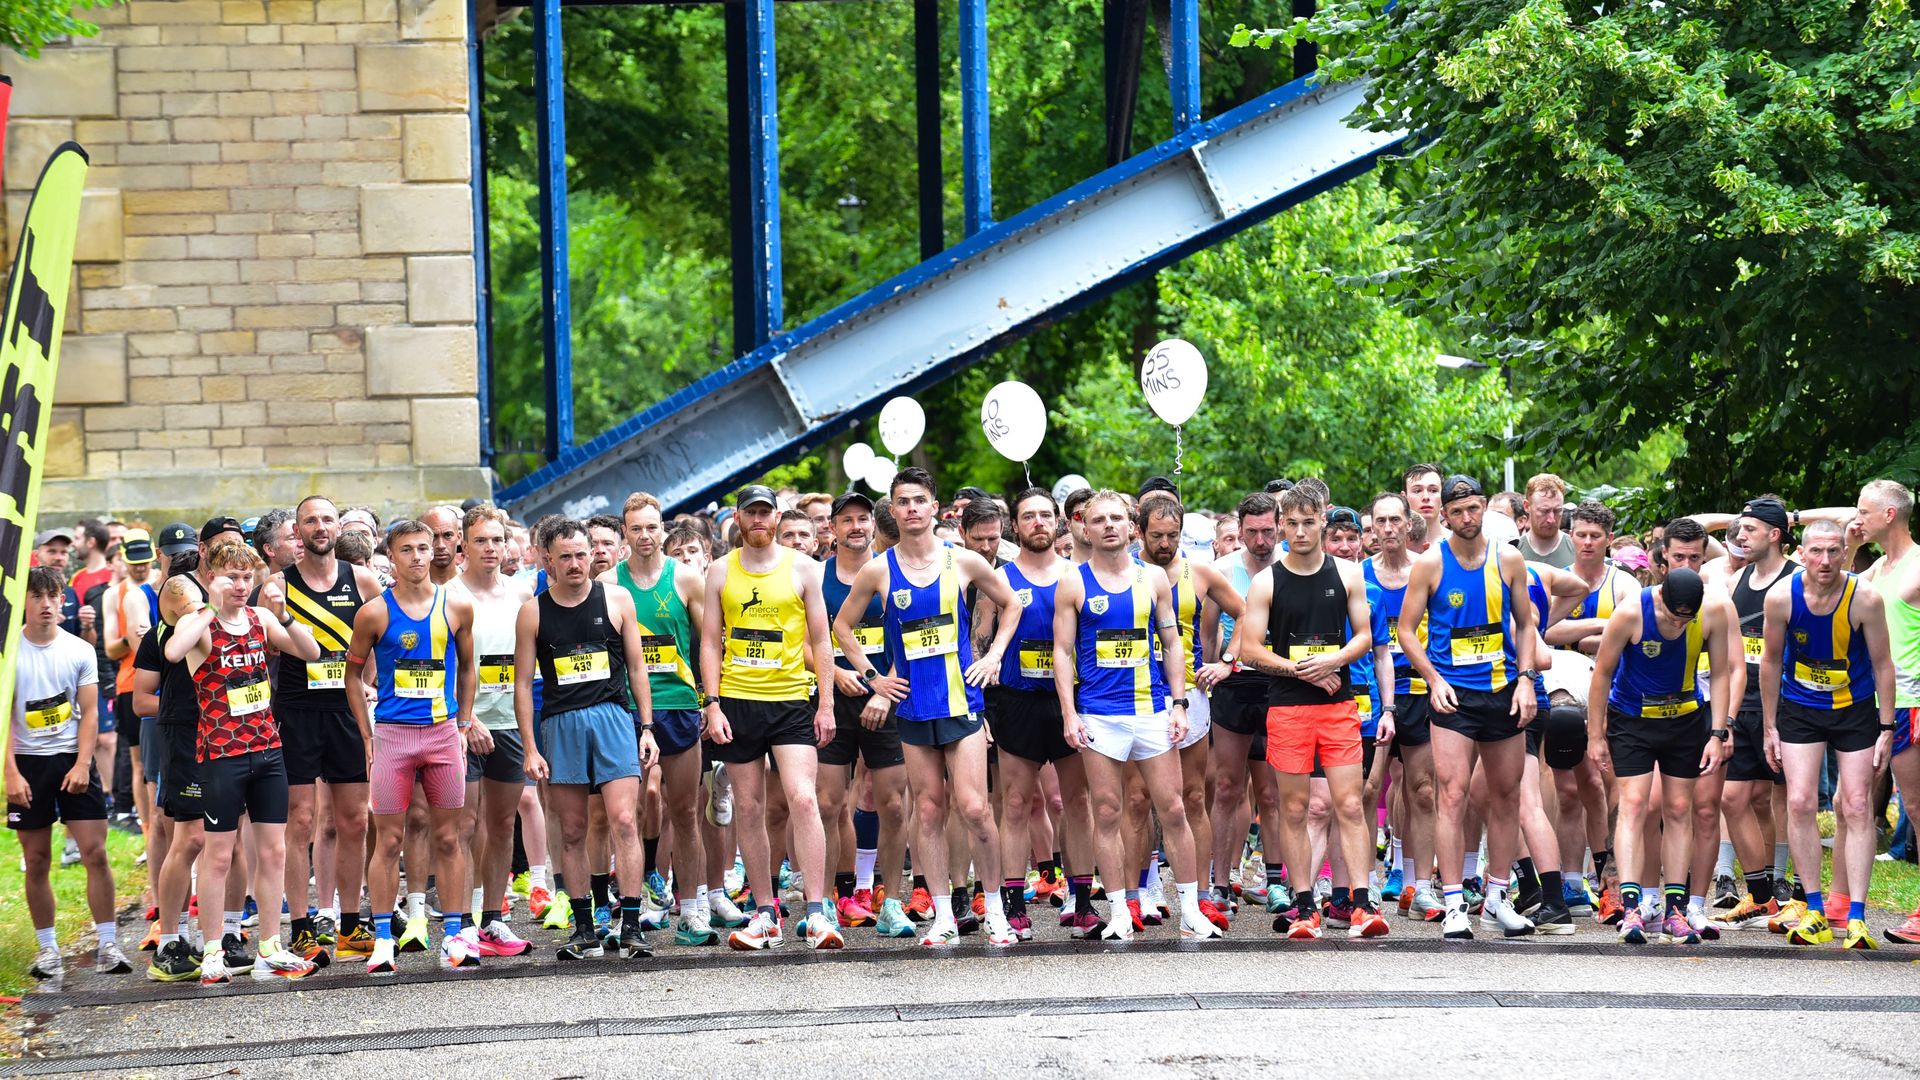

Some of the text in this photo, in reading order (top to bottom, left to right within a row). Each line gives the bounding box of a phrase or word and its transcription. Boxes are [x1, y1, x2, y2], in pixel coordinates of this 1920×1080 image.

[1143, 368, 1181, 397] MINS
[749, 605, 779, 613] mercia
[919, 628, 939, 637] JAMES
[921, 636, 940, 647] 273
[1467, 636, 1489, 644] THOMAS
[746, 648, 765, 659] 1221
[1115, 648, 1133, 658] 597
[1473, 643, 1486, 654] 77
[1746, 644, 1762, 654] 1149
[570, 654, 593, 663] THOMAS
[327, 669, 342, 679] 813
[409, 670, 434, 678] RICHARD
[499, 672, 510, 683] 84
[1810, 673, 1831, 684] 1252
[415, 678, 428, 688] 111
[244, 691, 262, 704] 1069
[43, 714, 61, 726] 380
